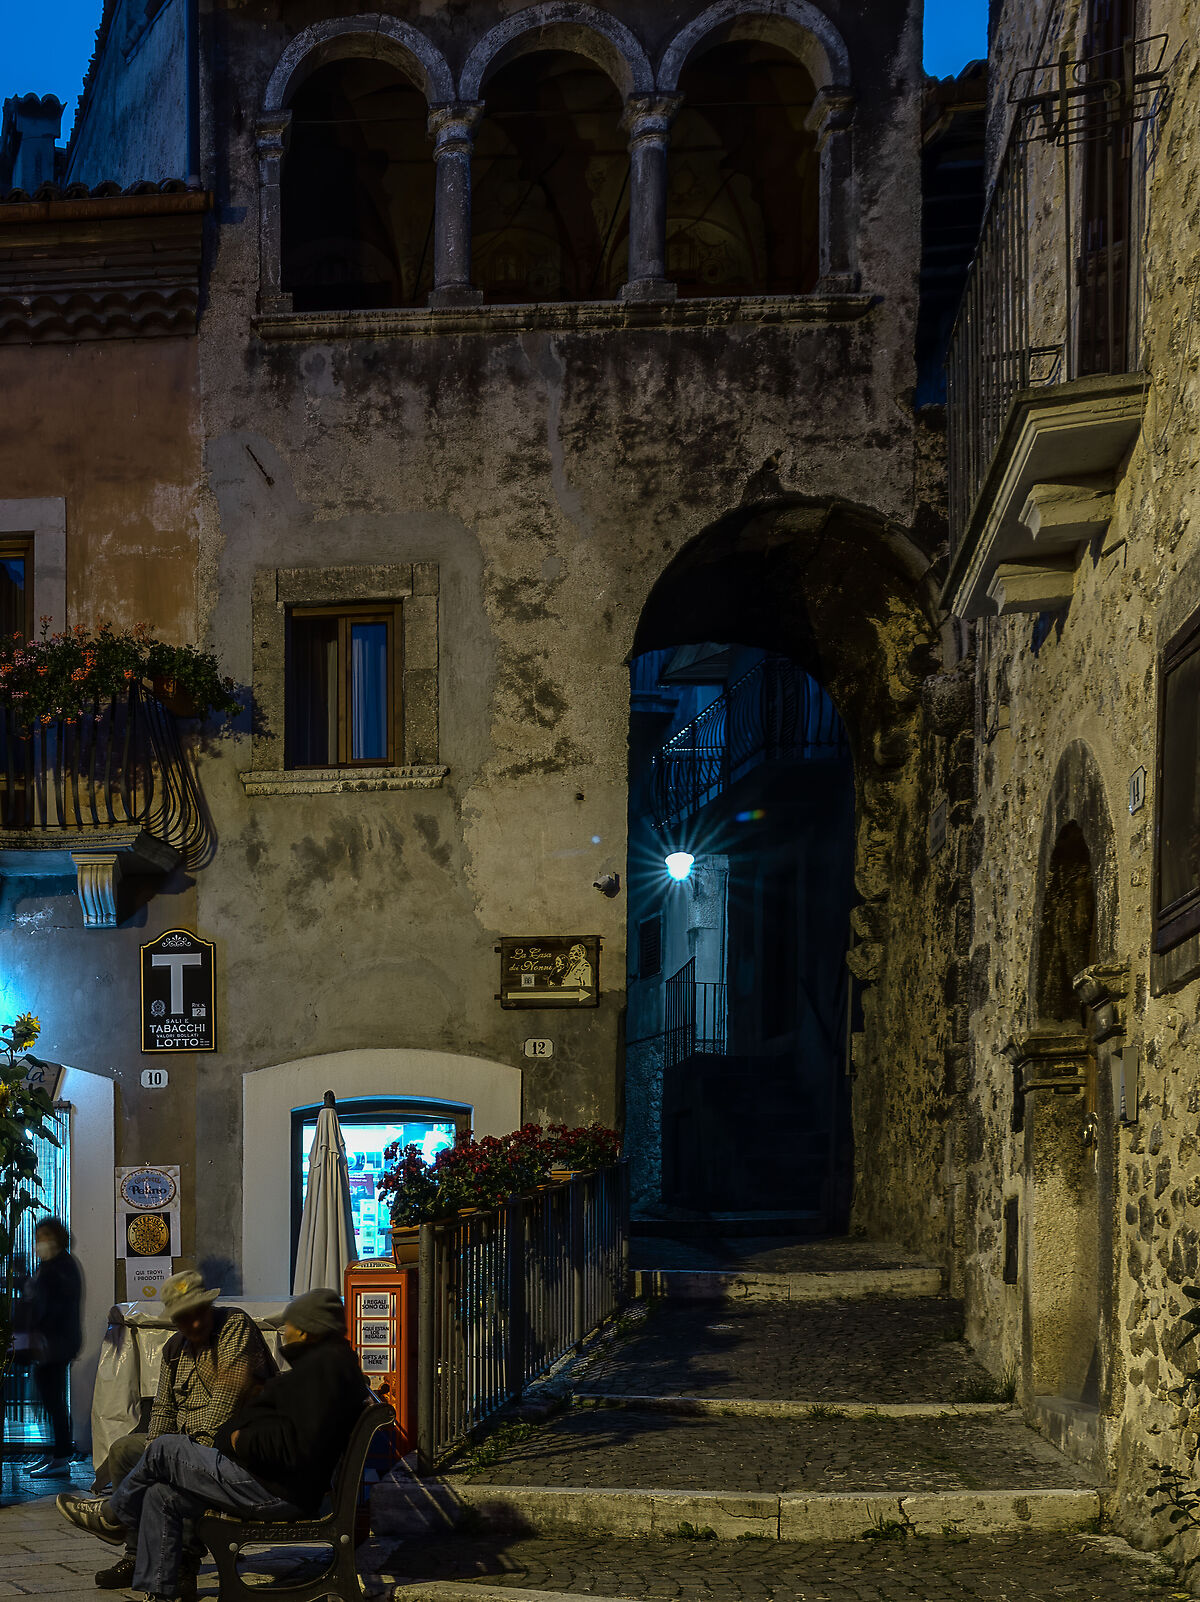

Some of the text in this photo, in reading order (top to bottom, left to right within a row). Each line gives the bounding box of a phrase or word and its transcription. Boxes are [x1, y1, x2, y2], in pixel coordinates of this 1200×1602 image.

[152, 953, 202, 1015] T
[149, 1023, 206, 1034] TABACCHI
[156, 1038, 199, 1048] LOTTO
[531, 1041, 546, 1055] 12
[148, 1071, 162, 1085] 10
